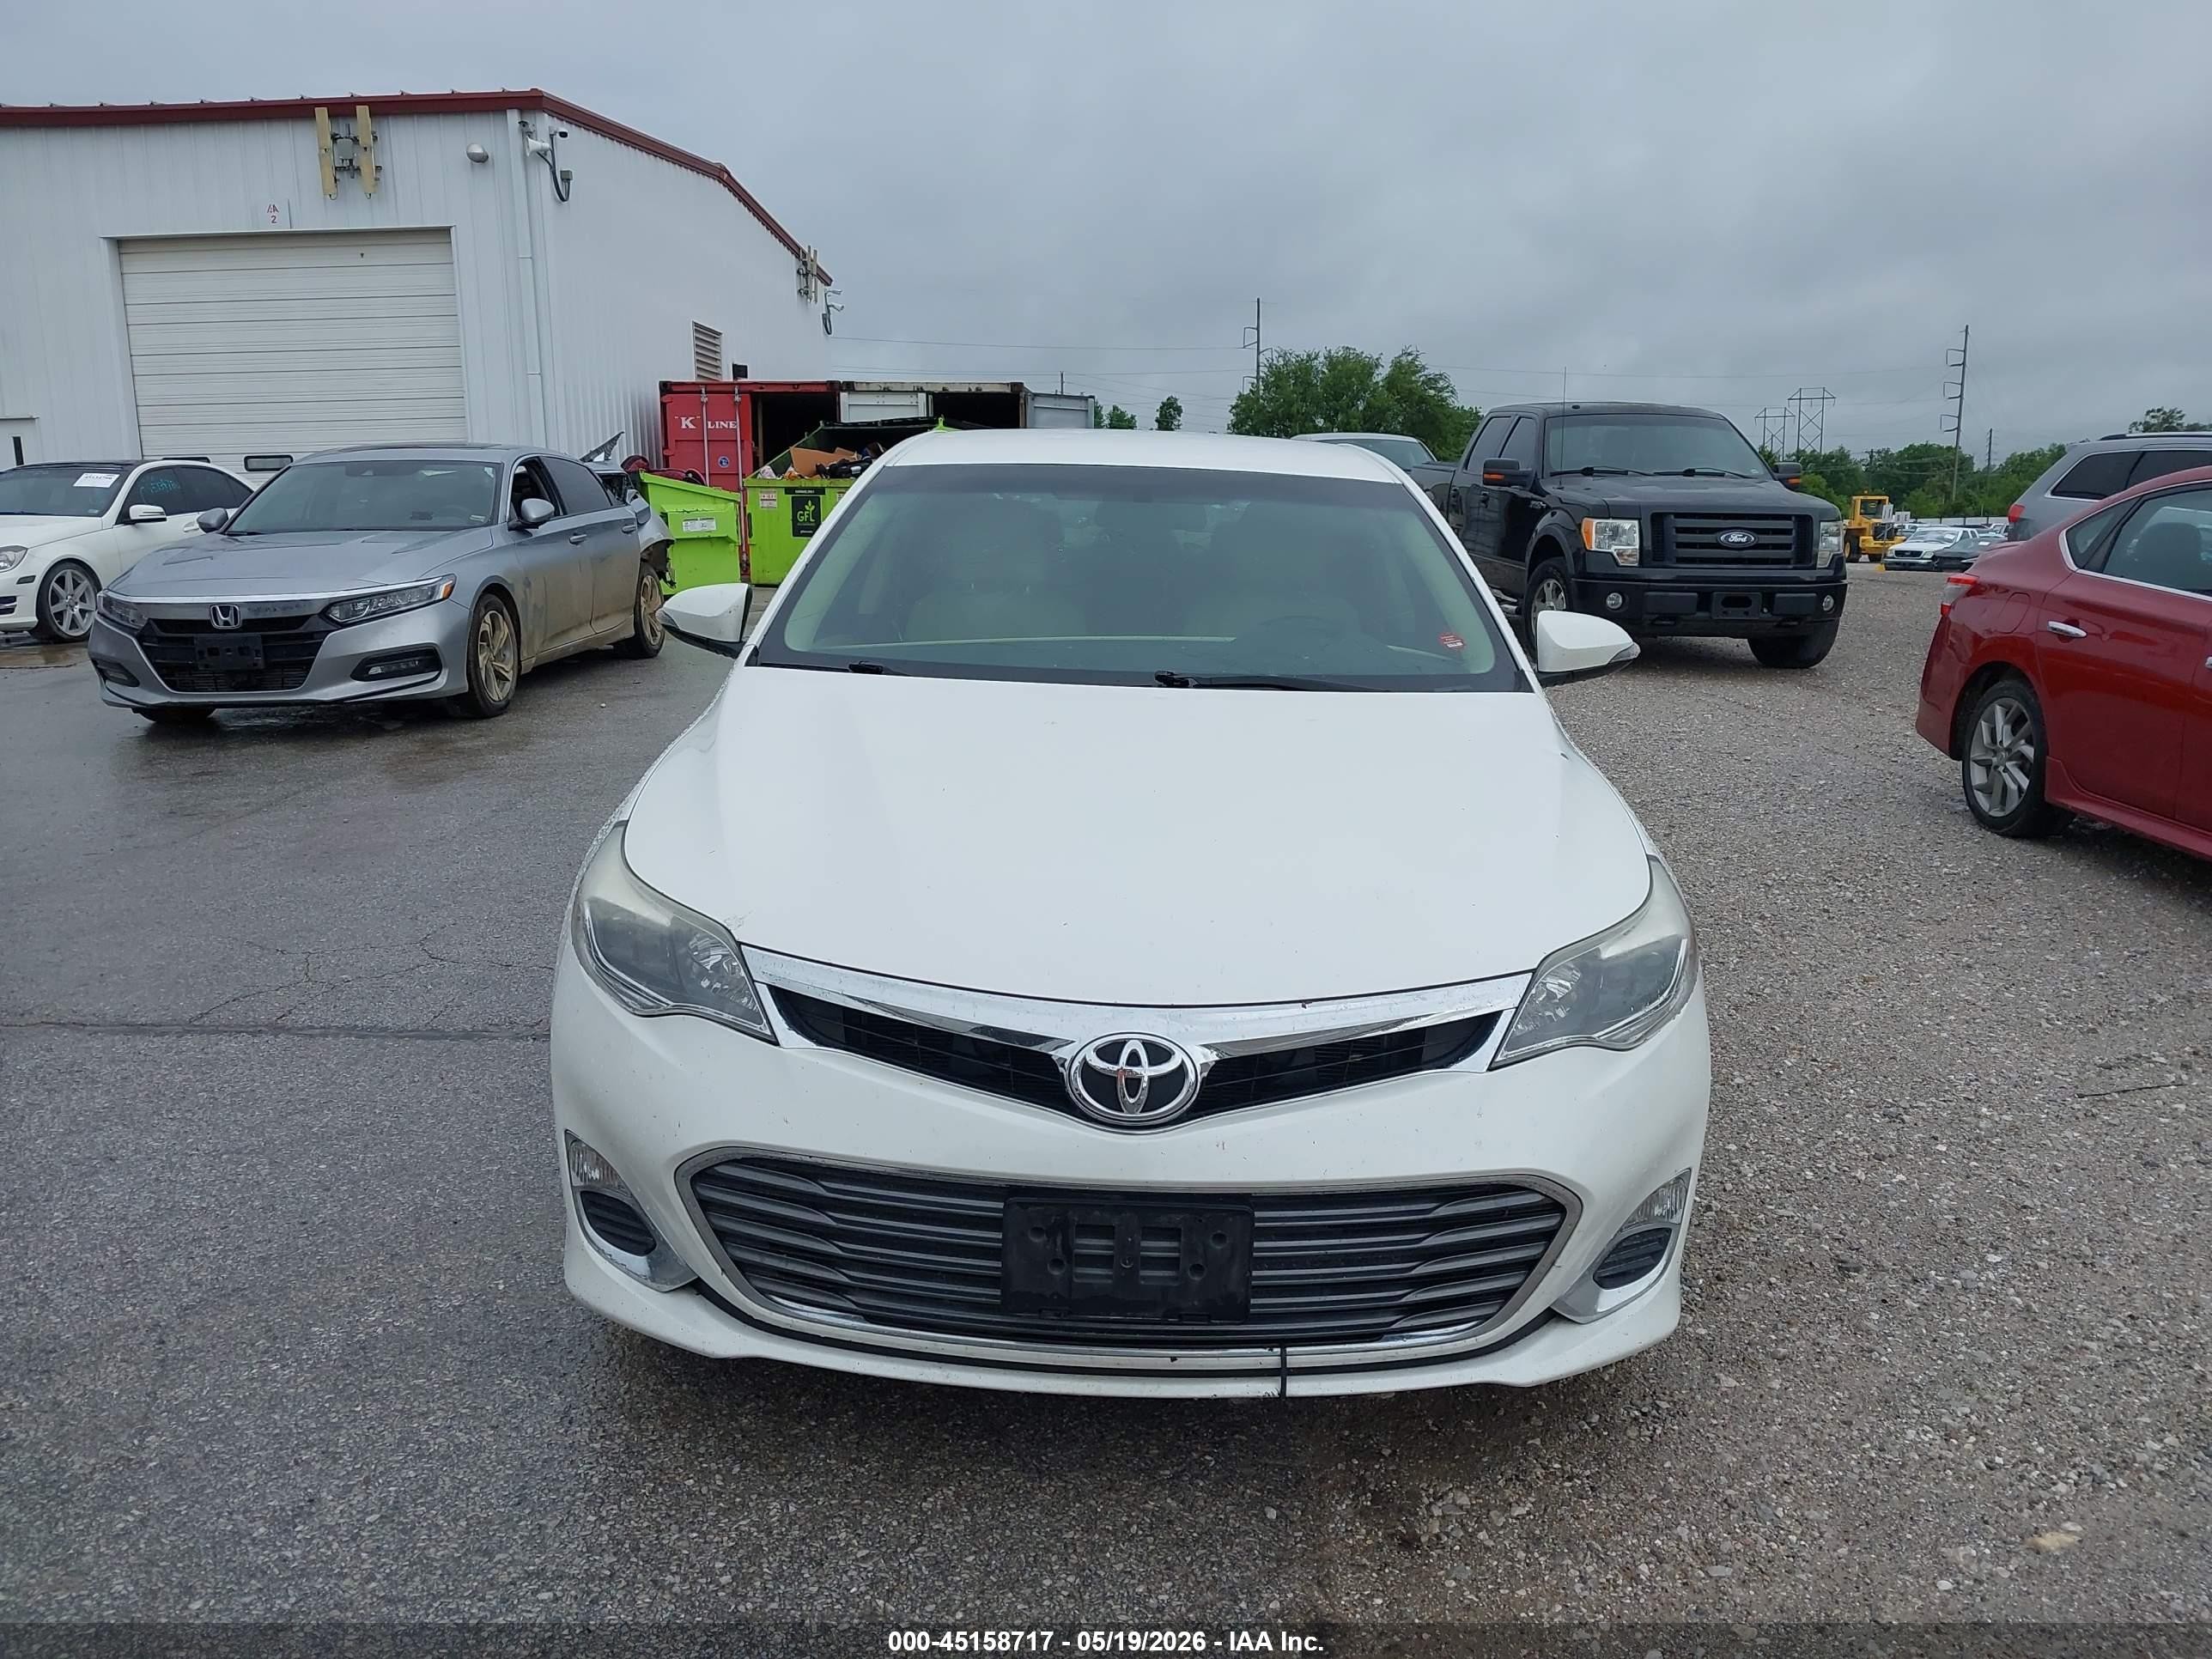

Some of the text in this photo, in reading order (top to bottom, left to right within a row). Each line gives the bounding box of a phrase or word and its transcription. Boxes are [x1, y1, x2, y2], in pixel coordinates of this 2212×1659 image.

[270, 215, 277, 224] 2
[707, 419, 738, 429] LINE
[796, 510, 816, 522] GFL
[1728, 533, 1748, 543] Ford
